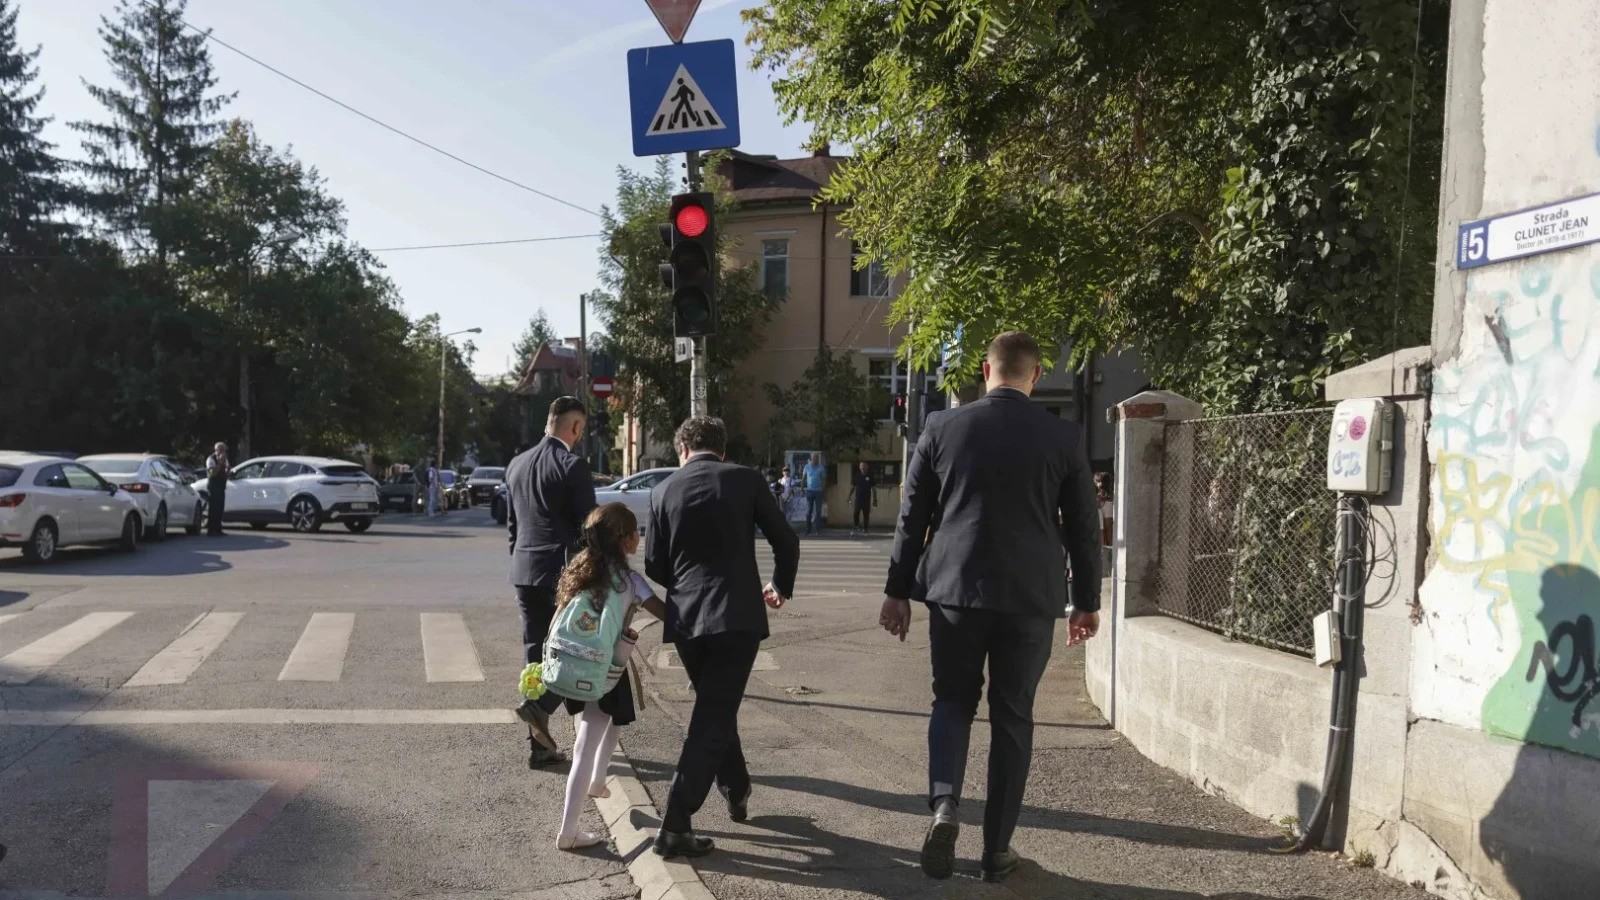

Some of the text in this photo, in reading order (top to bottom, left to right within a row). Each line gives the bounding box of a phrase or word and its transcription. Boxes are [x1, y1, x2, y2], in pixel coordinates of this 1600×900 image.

[1514, 216, 1589, 241] CLUNET JEAN
[1534, 207, 1569, 225] Strada
[1468, 226, 1484, 261] 5
